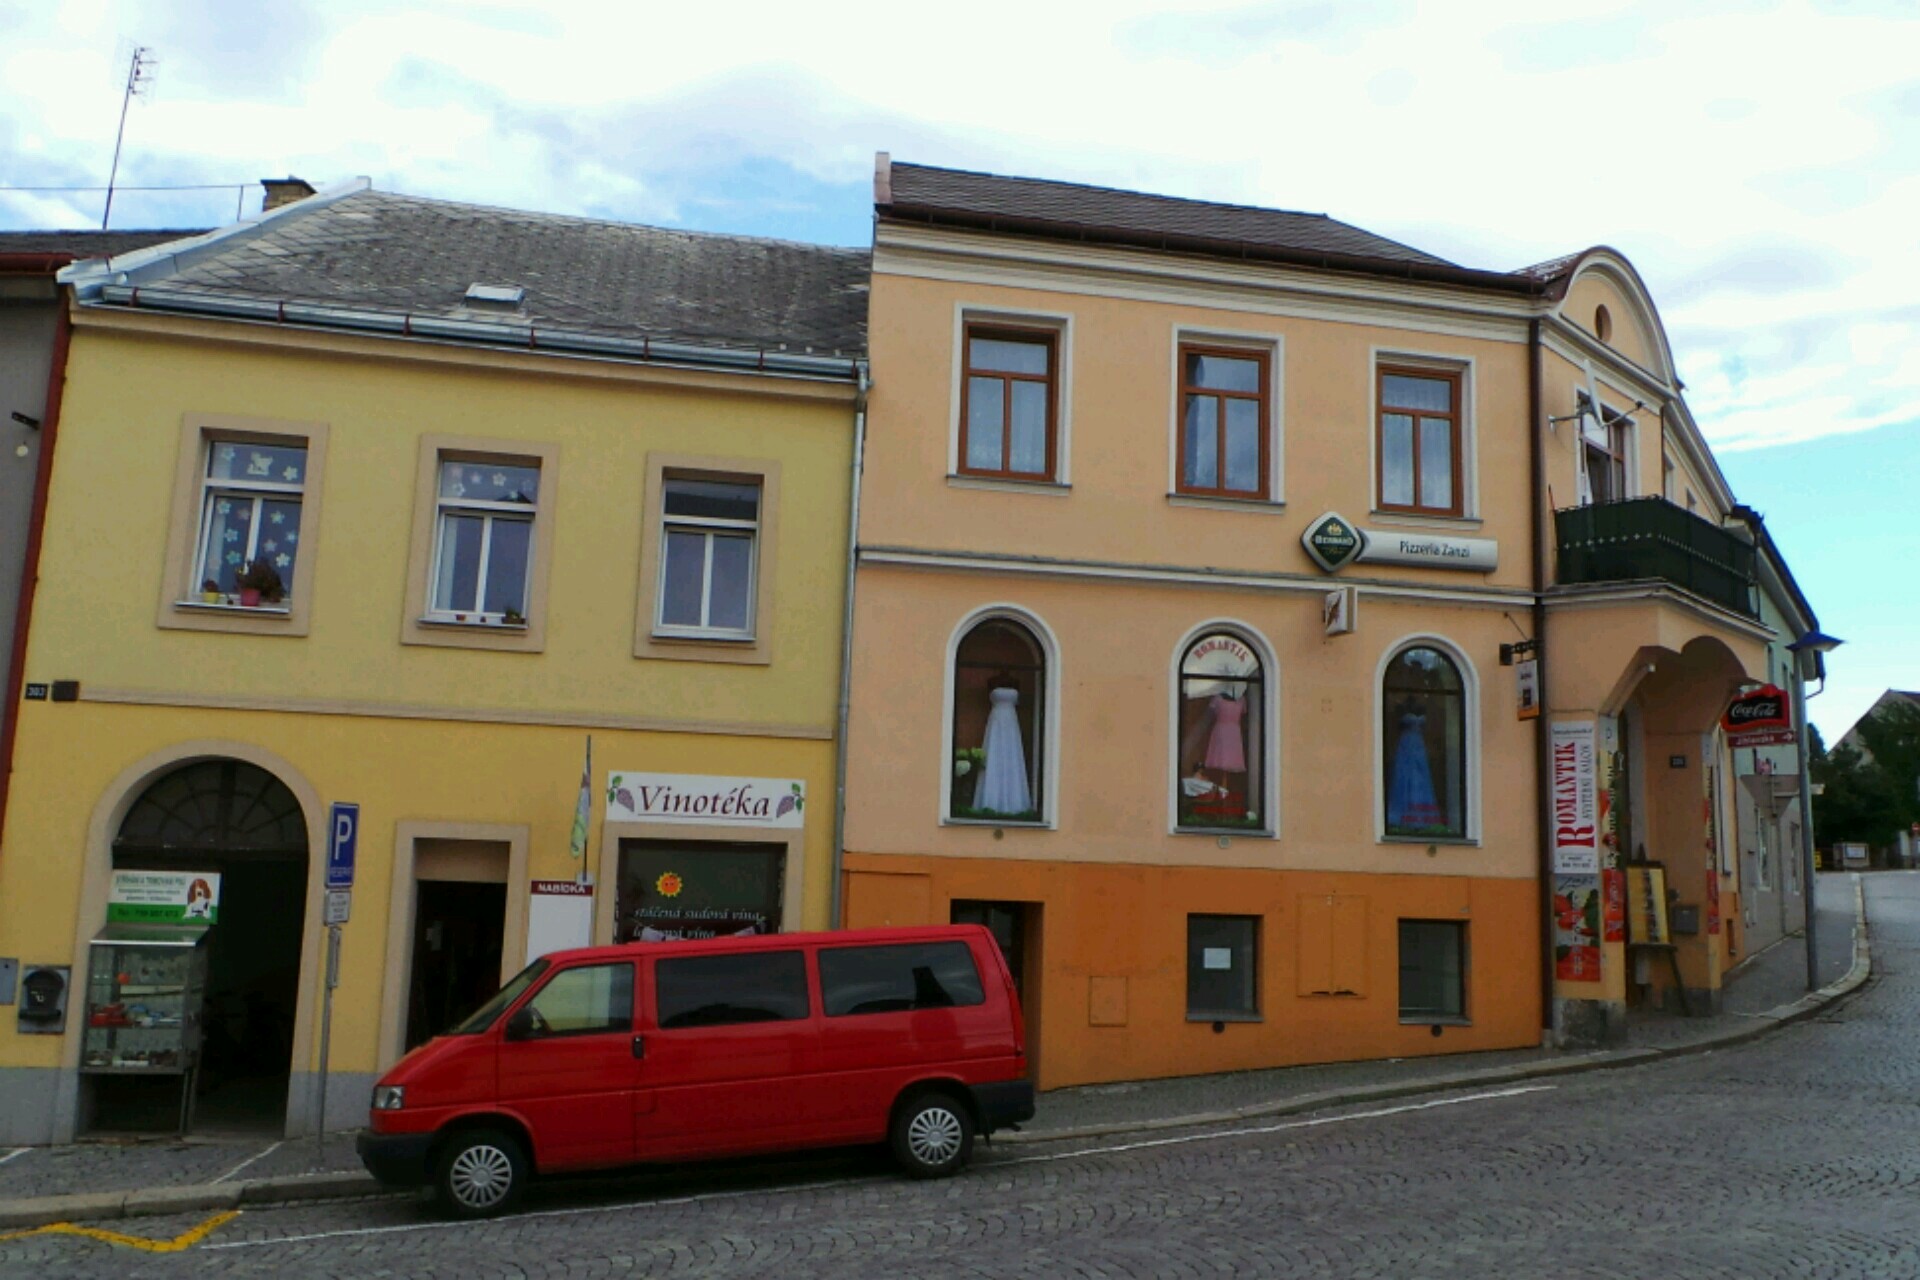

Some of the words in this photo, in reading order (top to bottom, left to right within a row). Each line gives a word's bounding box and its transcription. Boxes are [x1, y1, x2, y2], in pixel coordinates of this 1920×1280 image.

[1400, 541, 1440, 556] Pizzeria
[1442, 544, 1471, 558] Zanzi
[638, 784, 771, 816] Vinotéka
[1555, 742, 1595, 848] ROMANTIK
[334, 814, 353, 860] P
[537, 882, 586, 894] NABÍDKA
[633, 906, 681, 918] stáčená
[684, 907, 729, 920] sudová
